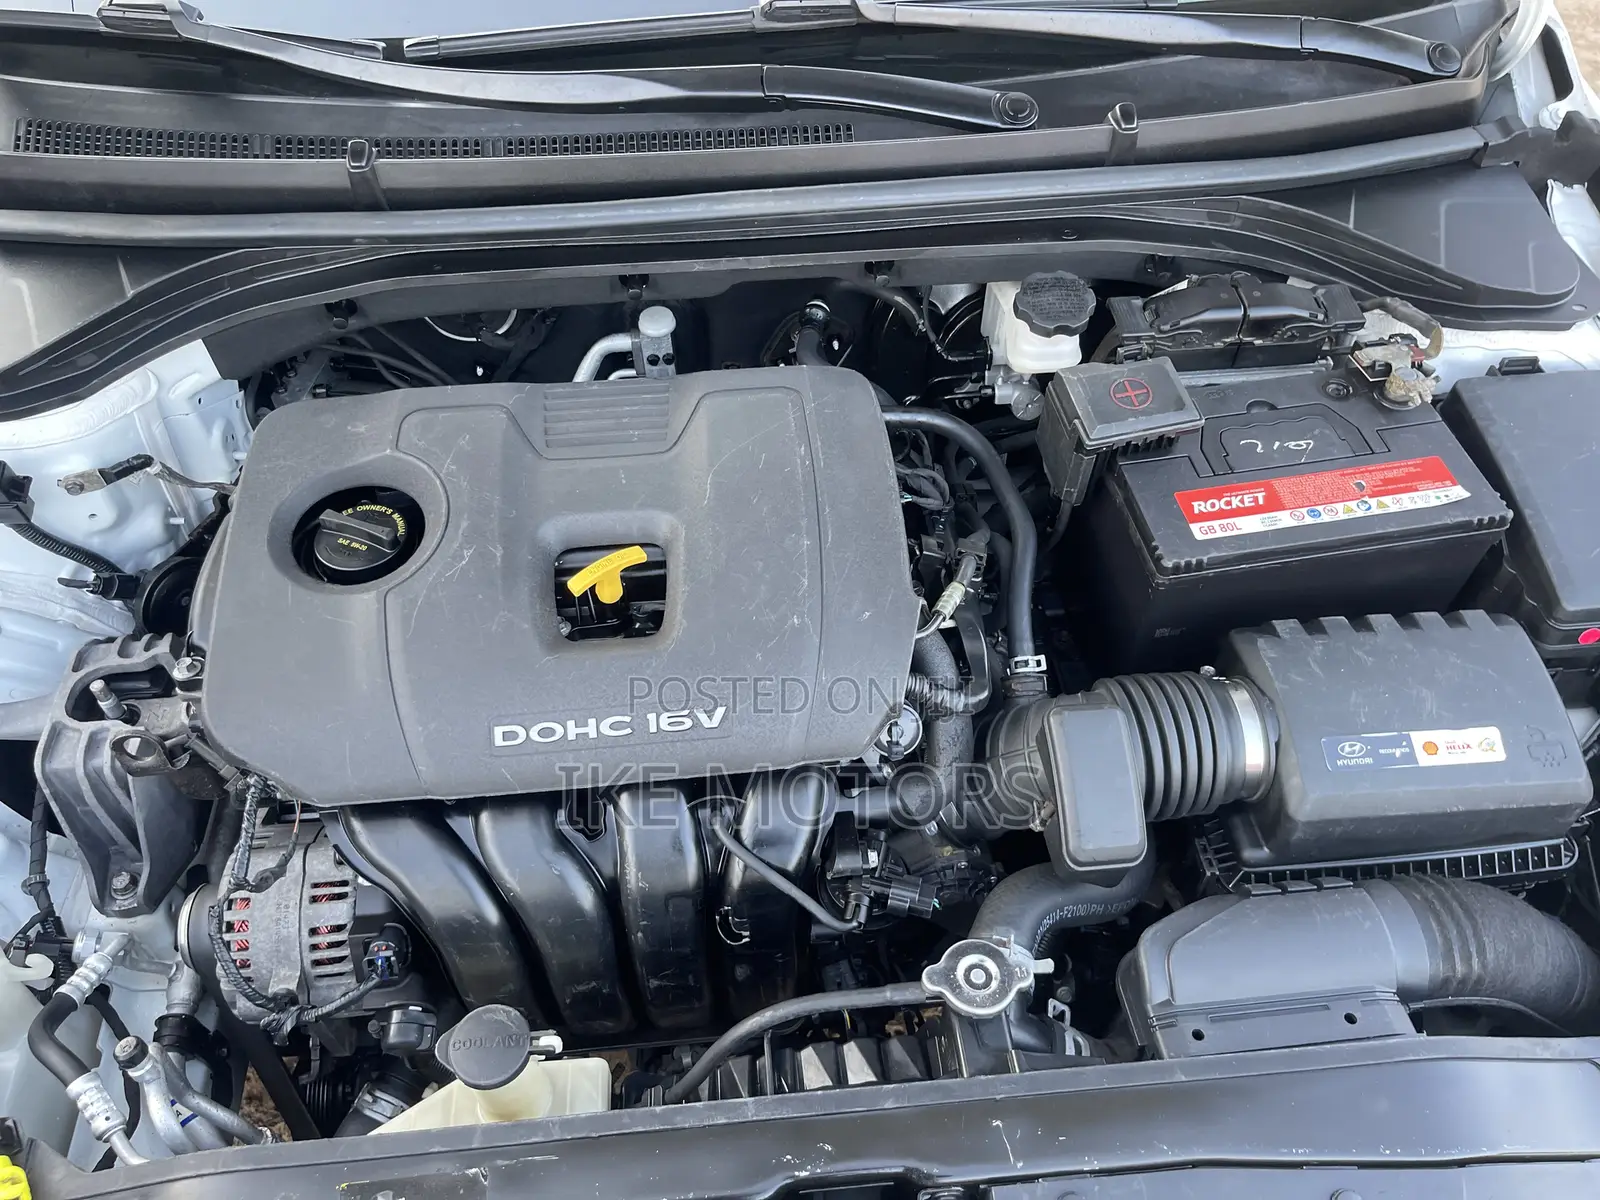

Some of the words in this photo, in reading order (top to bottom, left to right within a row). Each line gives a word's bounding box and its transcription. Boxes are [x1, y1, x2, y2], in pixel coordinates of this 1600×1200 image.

[1191, 492, 1266, 514] ROCKET
[342, 508, 354, 516] EE
[357, 505, 393, 514] OWNER'S
[392, 513, 405, 537] MANUAL
[1199, 525, 1217, 536] GB
[1220, 522, 1243, 533] 80L
[337, 538, 350, 546] SAE
[494, 715, 633, 747] DOHC
[647, 706, 727, 734] 16V
[1336, 757, 1374, 767] HYUNDAI
[452, 1034, 528, 1051] COOLANT
